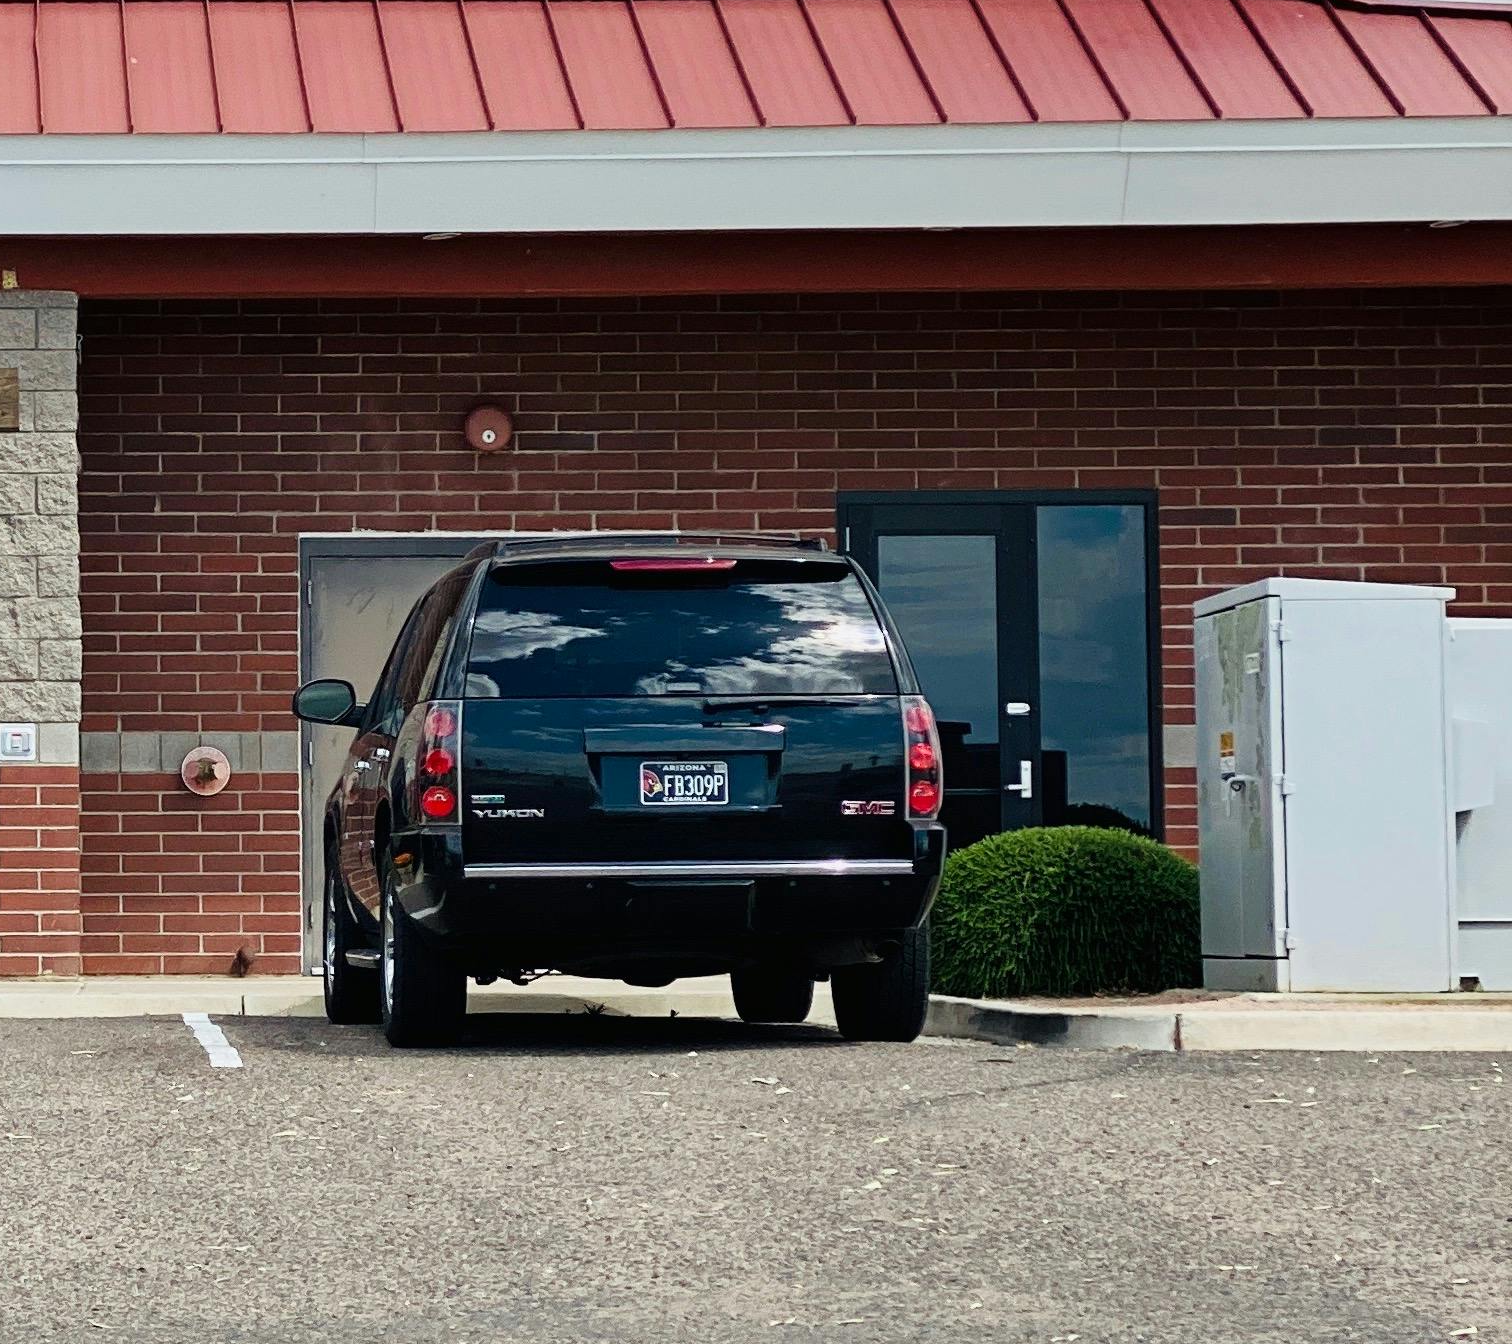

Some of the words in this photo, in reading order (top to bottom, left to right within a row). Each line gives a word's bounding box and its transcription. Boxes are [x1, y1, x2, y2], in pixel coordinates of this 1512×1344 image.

[662, 764, 706, 772] ARIZONA
[664, 775, 724, 796] FB309P
[471, 809, 545, 818] YUKON
[841, 800, 895, 815] GMC
